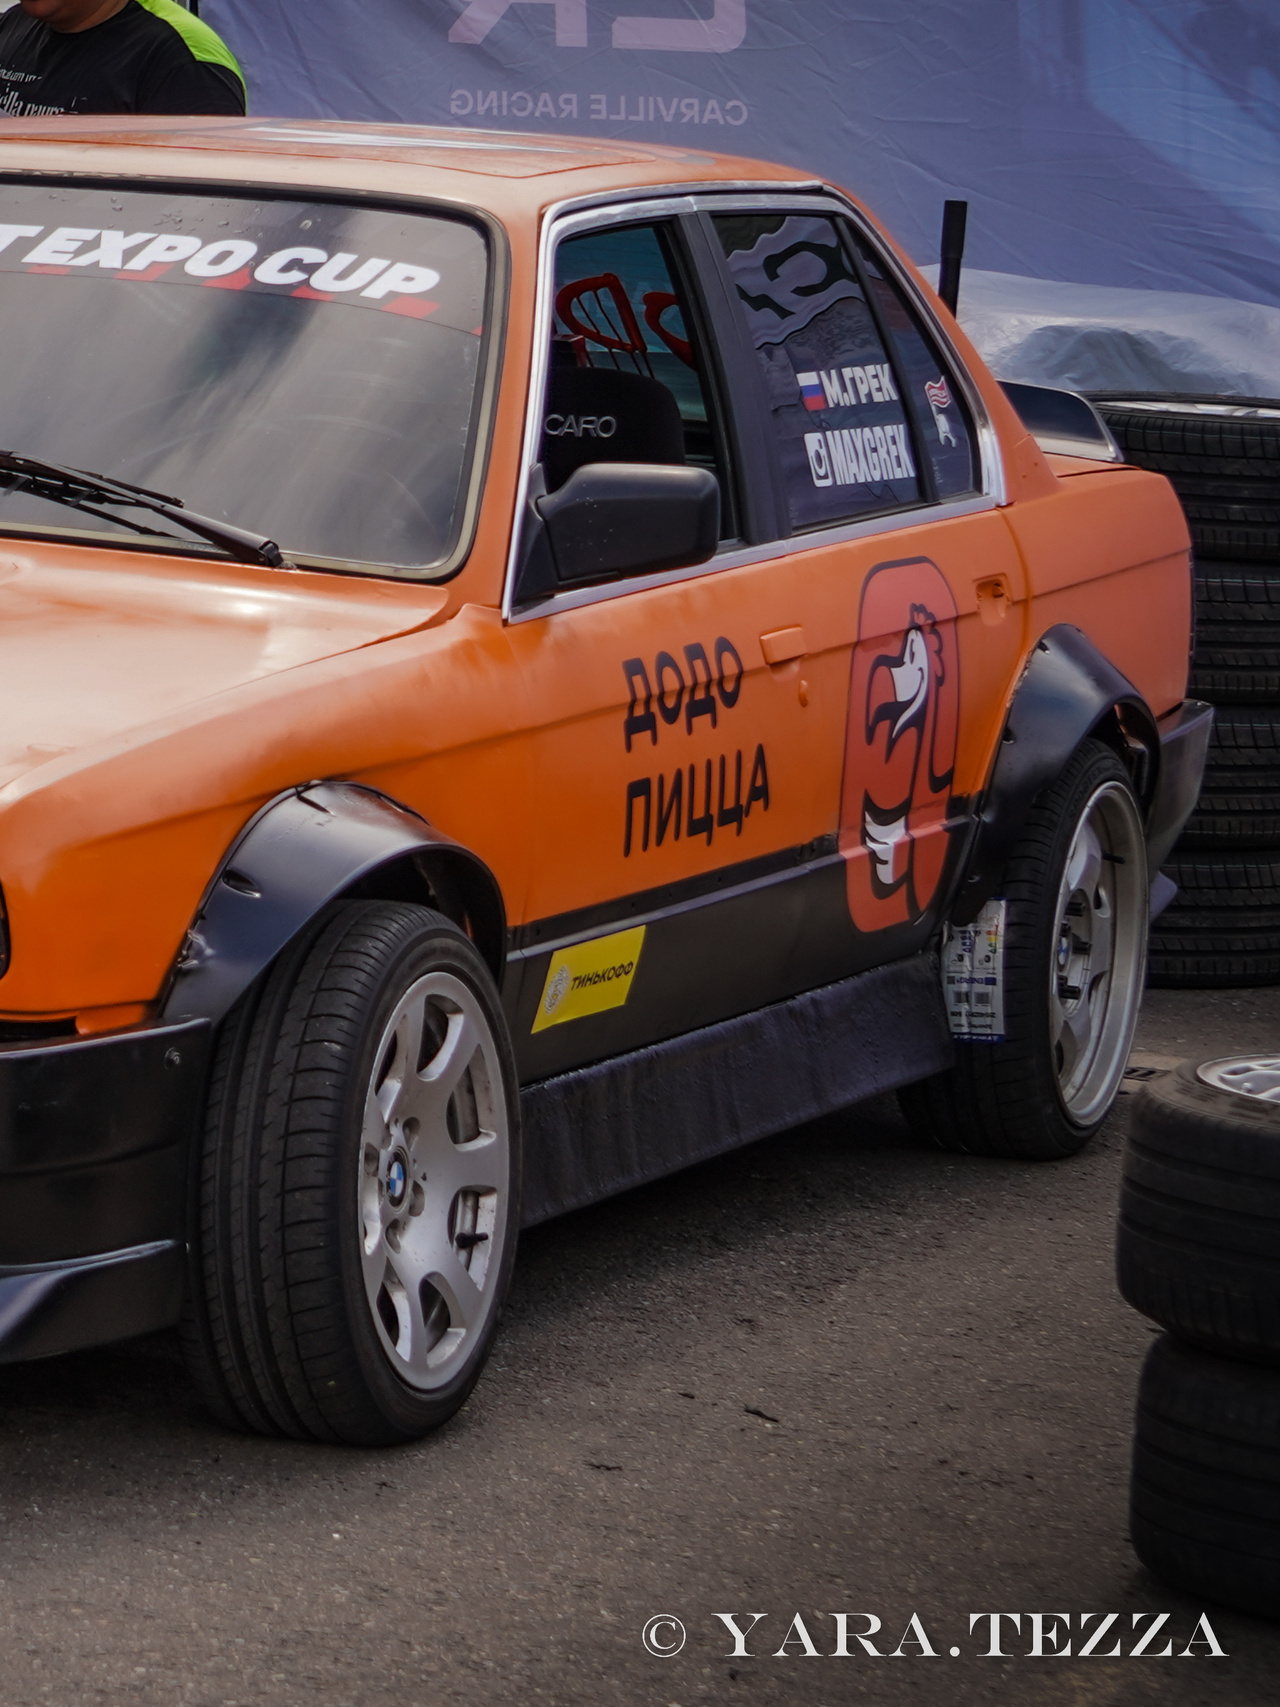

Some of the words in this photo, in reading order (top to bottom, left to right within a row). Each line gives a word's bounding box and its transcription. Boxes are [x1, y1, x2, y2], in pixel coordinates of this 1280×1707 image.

[21, 228, 257, 277] EXPO
[254, 247, 440, 299] CUP
[820, 363, 898, 408] М.ГРЕК
[544, 414, 617, 438] CARO
[825, 424, 915, 486] MAXGREK
[622, 636, 743, 753] ДОДО
[623, 743, 769, 858] ПИЦЦА
[571, 961, 634, 991] ТИНЬКОФФ
